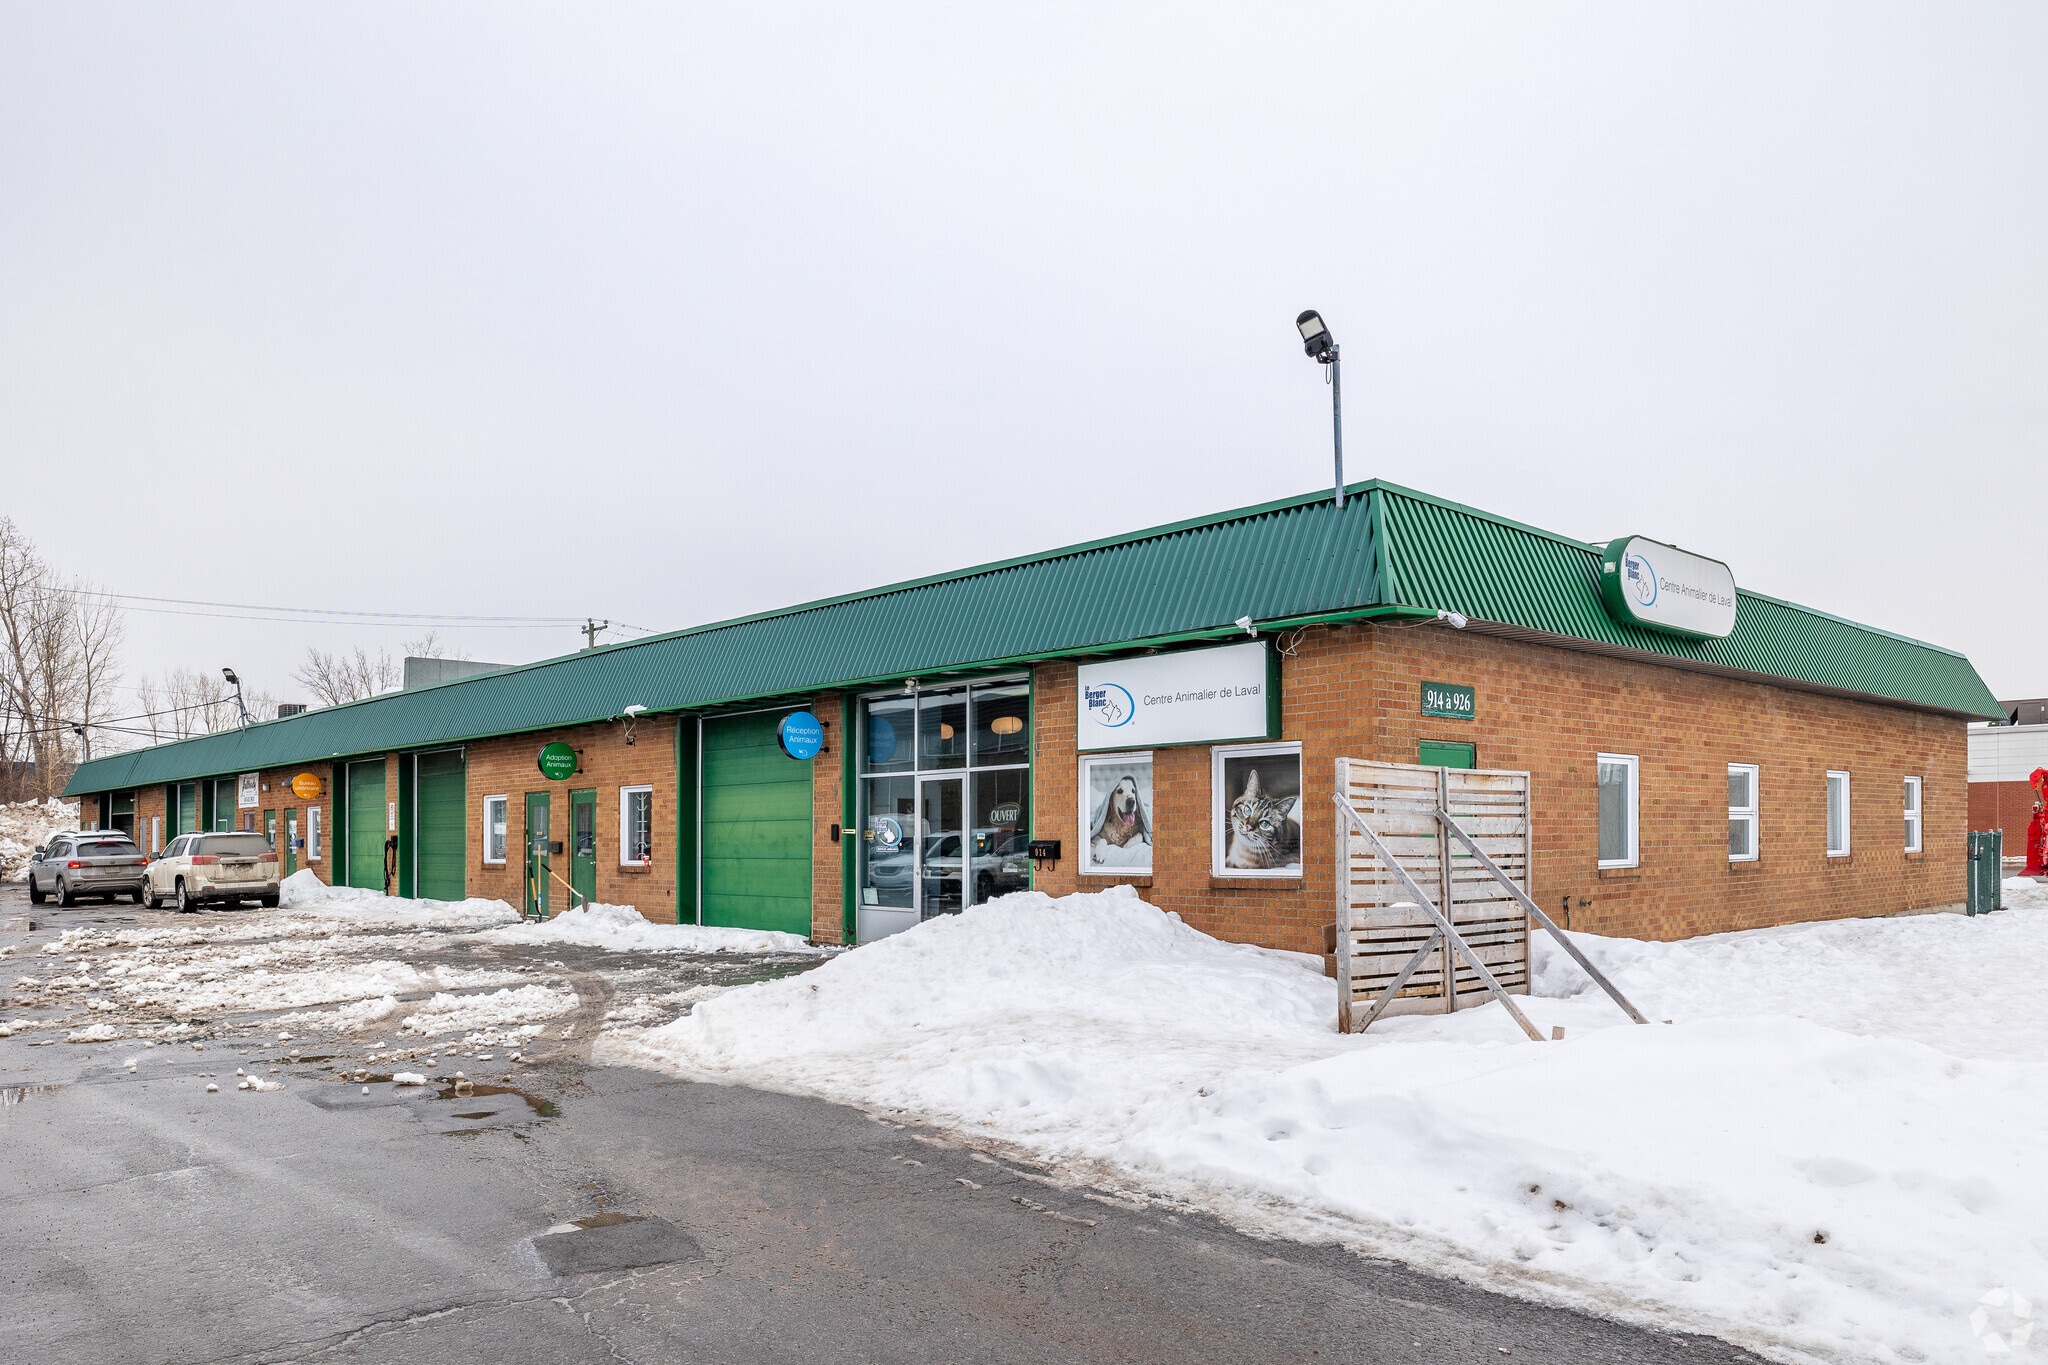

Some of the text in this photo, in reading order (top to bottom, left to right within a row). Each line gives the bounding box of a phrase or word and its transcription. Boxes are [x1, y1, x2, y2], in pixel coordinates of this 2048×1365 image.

[1625, 557, 1639, 570] Berger
[1659, 577, 1732, 607] Centre Animalier de Laval
[1084, 690, 1106, 700] Berger
[1143, 683, 1261, 706] Centre Animalier de Laval
[1088, 699, 1107, 708] Blanc
[1426, 690, 1471, 711] 914 à 926
[786, 725, 820, 736] Réception
[789, 735, 818, 744] Animaux
[545, 754, 573, 762] Adoption
[990, 809, 1018, 822] OUVERT
[1034, 847, 1047, 857] 914
